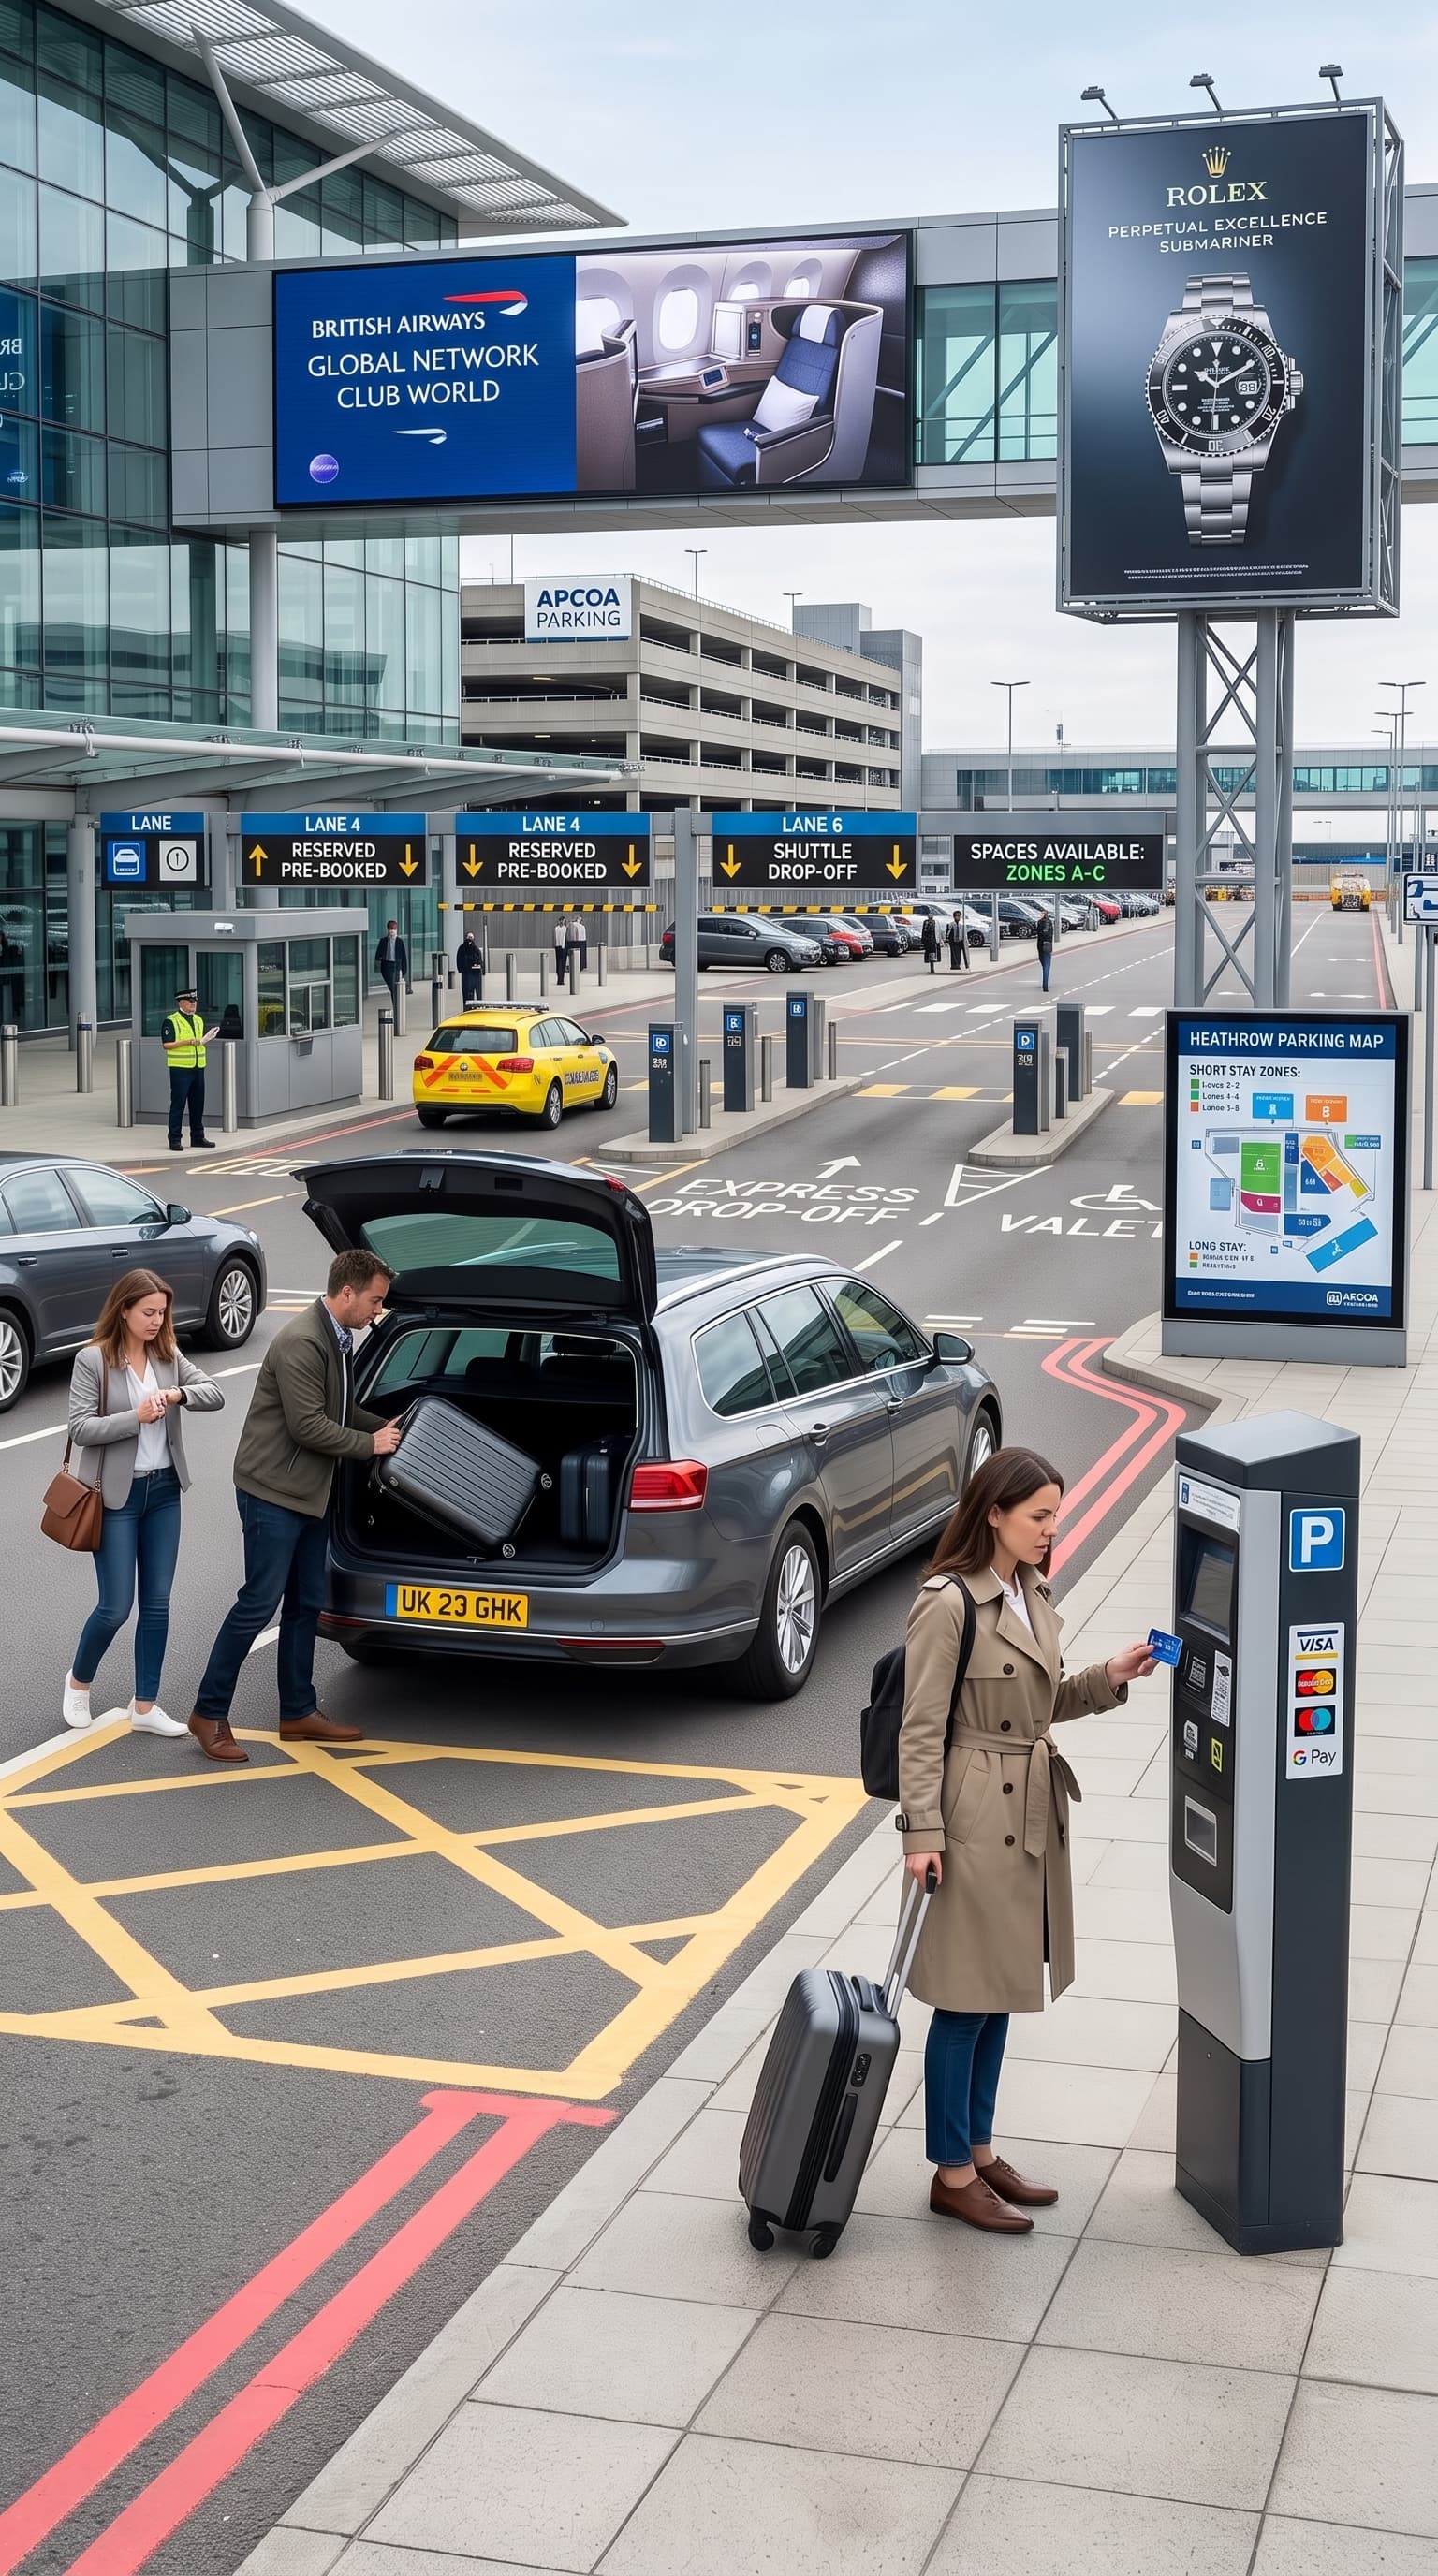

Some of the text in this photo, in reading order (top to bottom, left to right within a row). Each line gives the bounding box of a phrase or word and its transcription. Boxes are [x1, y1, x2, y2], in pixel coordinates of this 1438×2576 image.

[1167, 182, 1269, 207] ROLEX
[1108, 212, 1328, 239] PERPETUAL EXCELLENCE
[1160, 234, 1274, 253] SUBMARINER
[312, 311, 486, 339] BRITISH AIRWAYS
[308, 344, 540, 377] GLOBAL NETWORK
[337, 380, 501, 408] CLUB WORLD
[536, 588, 620, 607] APCOA
[536, 610, 621, 628] PARKING
[131, 815, 172, 831] LANE
[305, 817, 361, 832] LANE 4
[522, 816, 581, 832] LANE 4
[782, 816, 843, 833] LANE 6
[292, 842, 376, 858] RESERVED
[508, 842, 596, 858] RESERVED
[773, 843, 852, 859] SHUTTLE
[970, 843, 1145, 860] SPACES AVAILABLE:
[281, 863, 387, 879] PRE-BOOKED
[497, 863, 608, 879] PRE-BOOKED
[768, 864, 858, 880] DROP-OFF
[1006, 864, 1106, 881] ZONES A-C
[1190, 1032, 1384, 1049] HEATHROW PARKING MAP
[1190, 1064, 1301, 1077] SHORT STAY ZONES:
[674, 1179, 921, 1203] EXPRESS
[646, 1198, 910, 1226] DROP-OFF
[1189, 1240, 1247, 1252] LONG STAY:
[1301, 1516, 1334, 1564] P
[403, 1588, 521, 1622] UK 23 GHK
[1300, 1637, 1334, 1652] VISA
[1311, 1749, 1336, 1766] Pay
